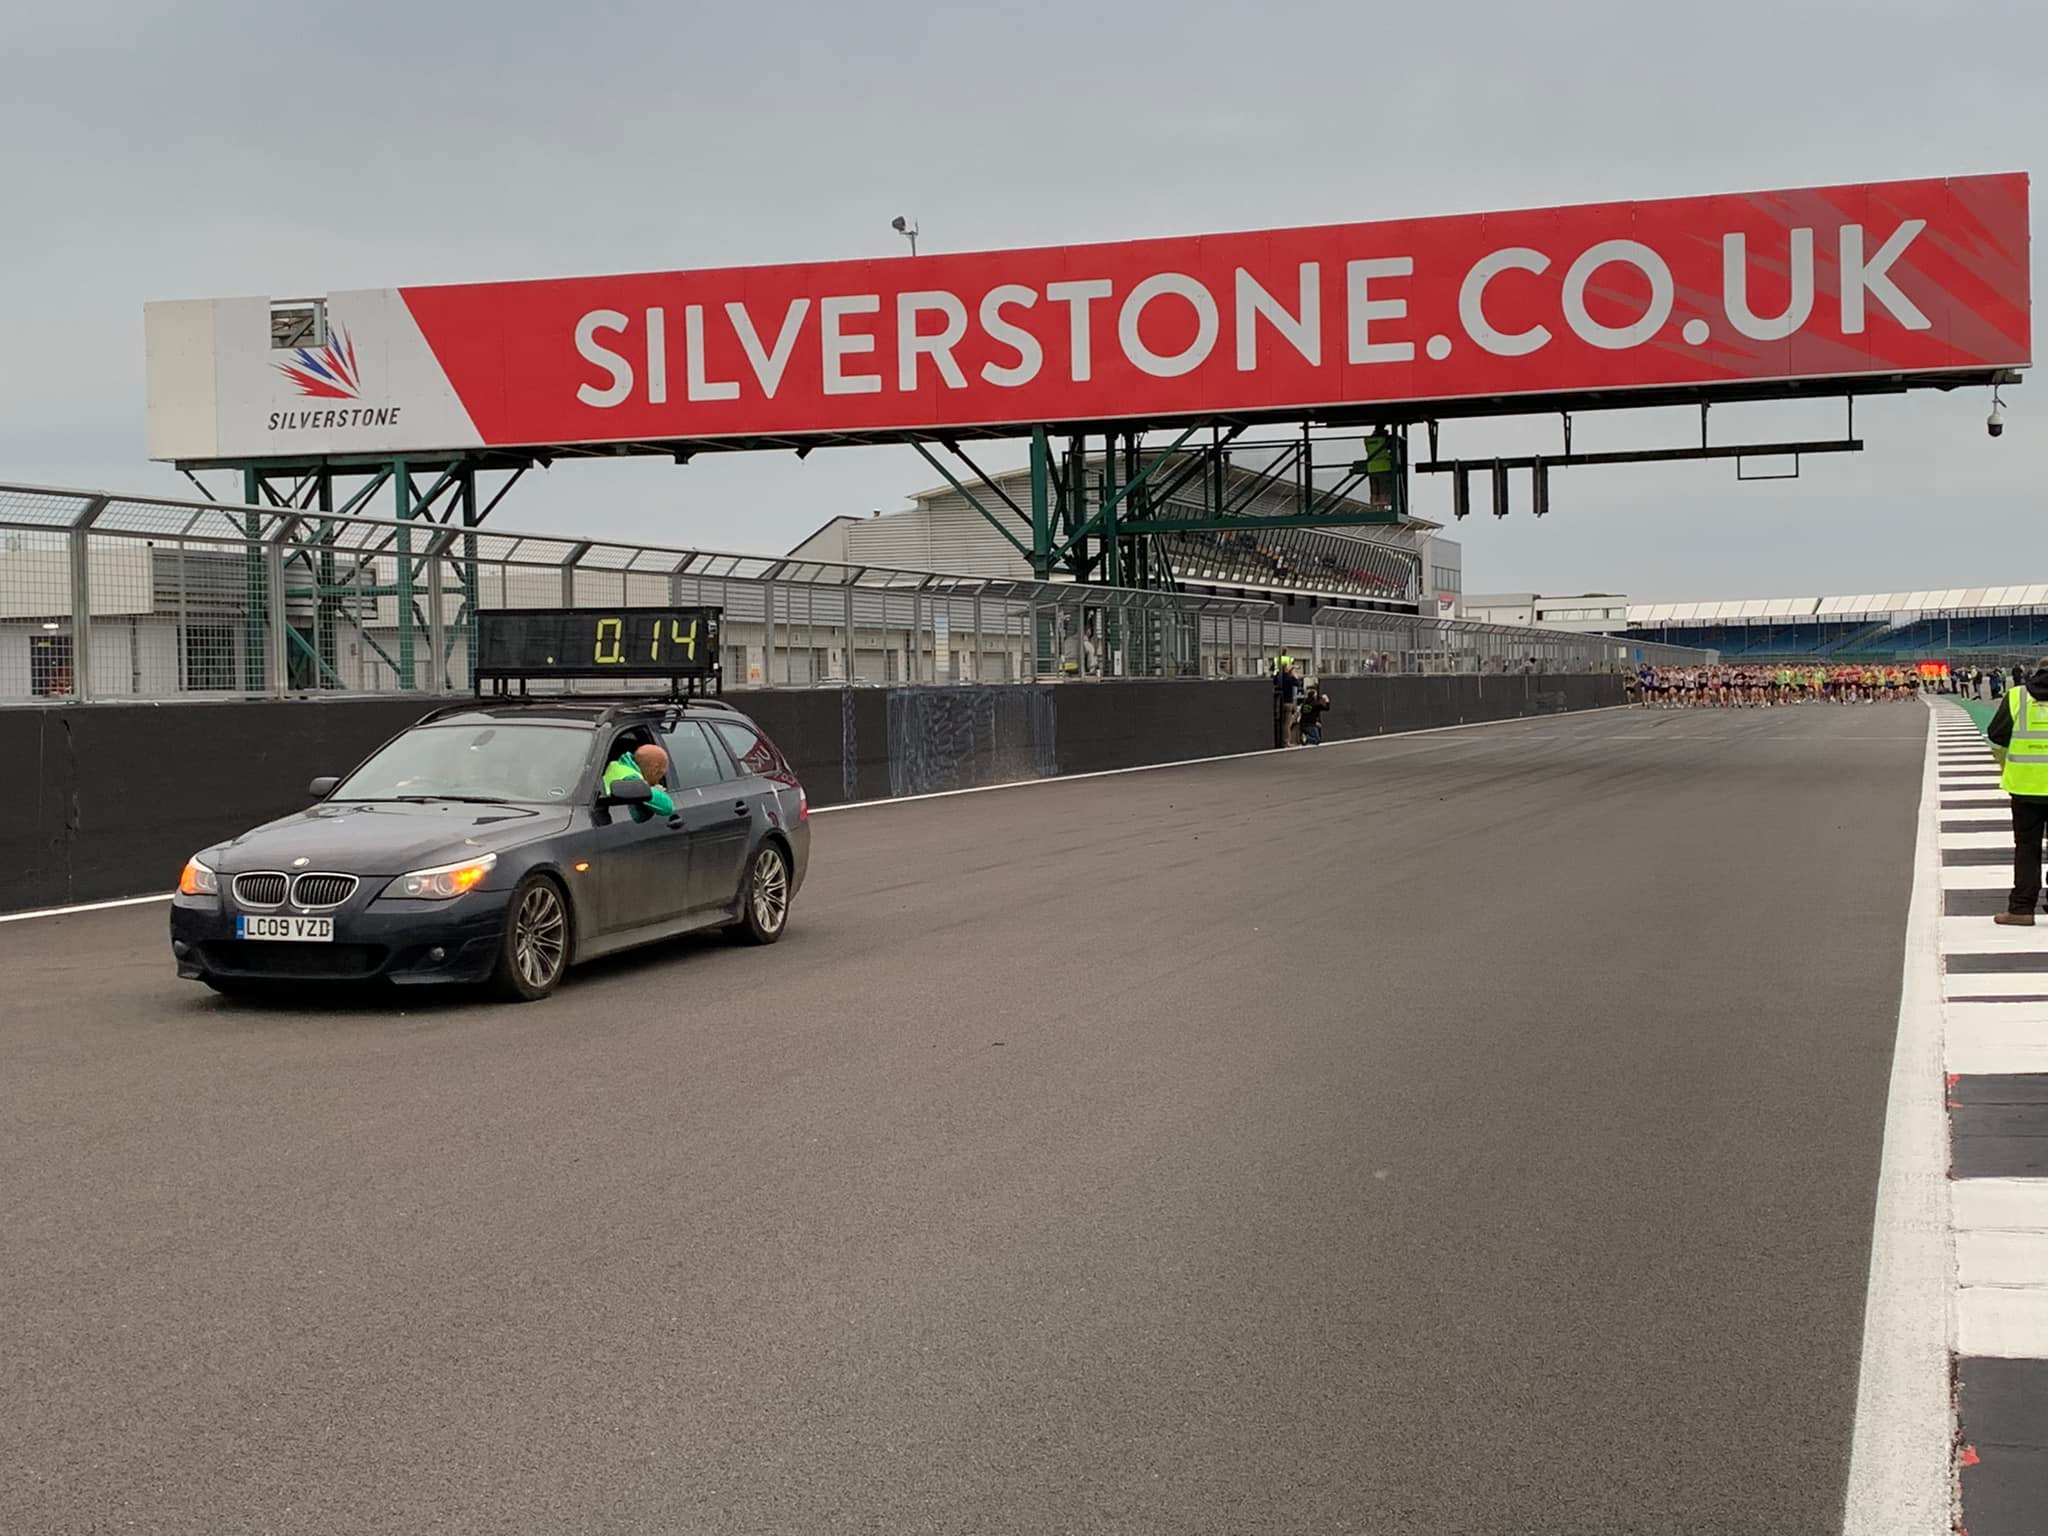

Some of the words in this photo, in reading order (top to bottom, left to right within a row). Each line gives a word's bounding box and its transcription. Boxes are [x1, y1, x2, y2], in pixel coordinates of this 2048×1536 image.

[575, 219, 1933, 408] SILVERSTONE.CO.UK
[268, 407, 401, 430] SILVERSTONE
[246, 918, 290, 936] LC09
[296, 919, 330, 936] VZD
